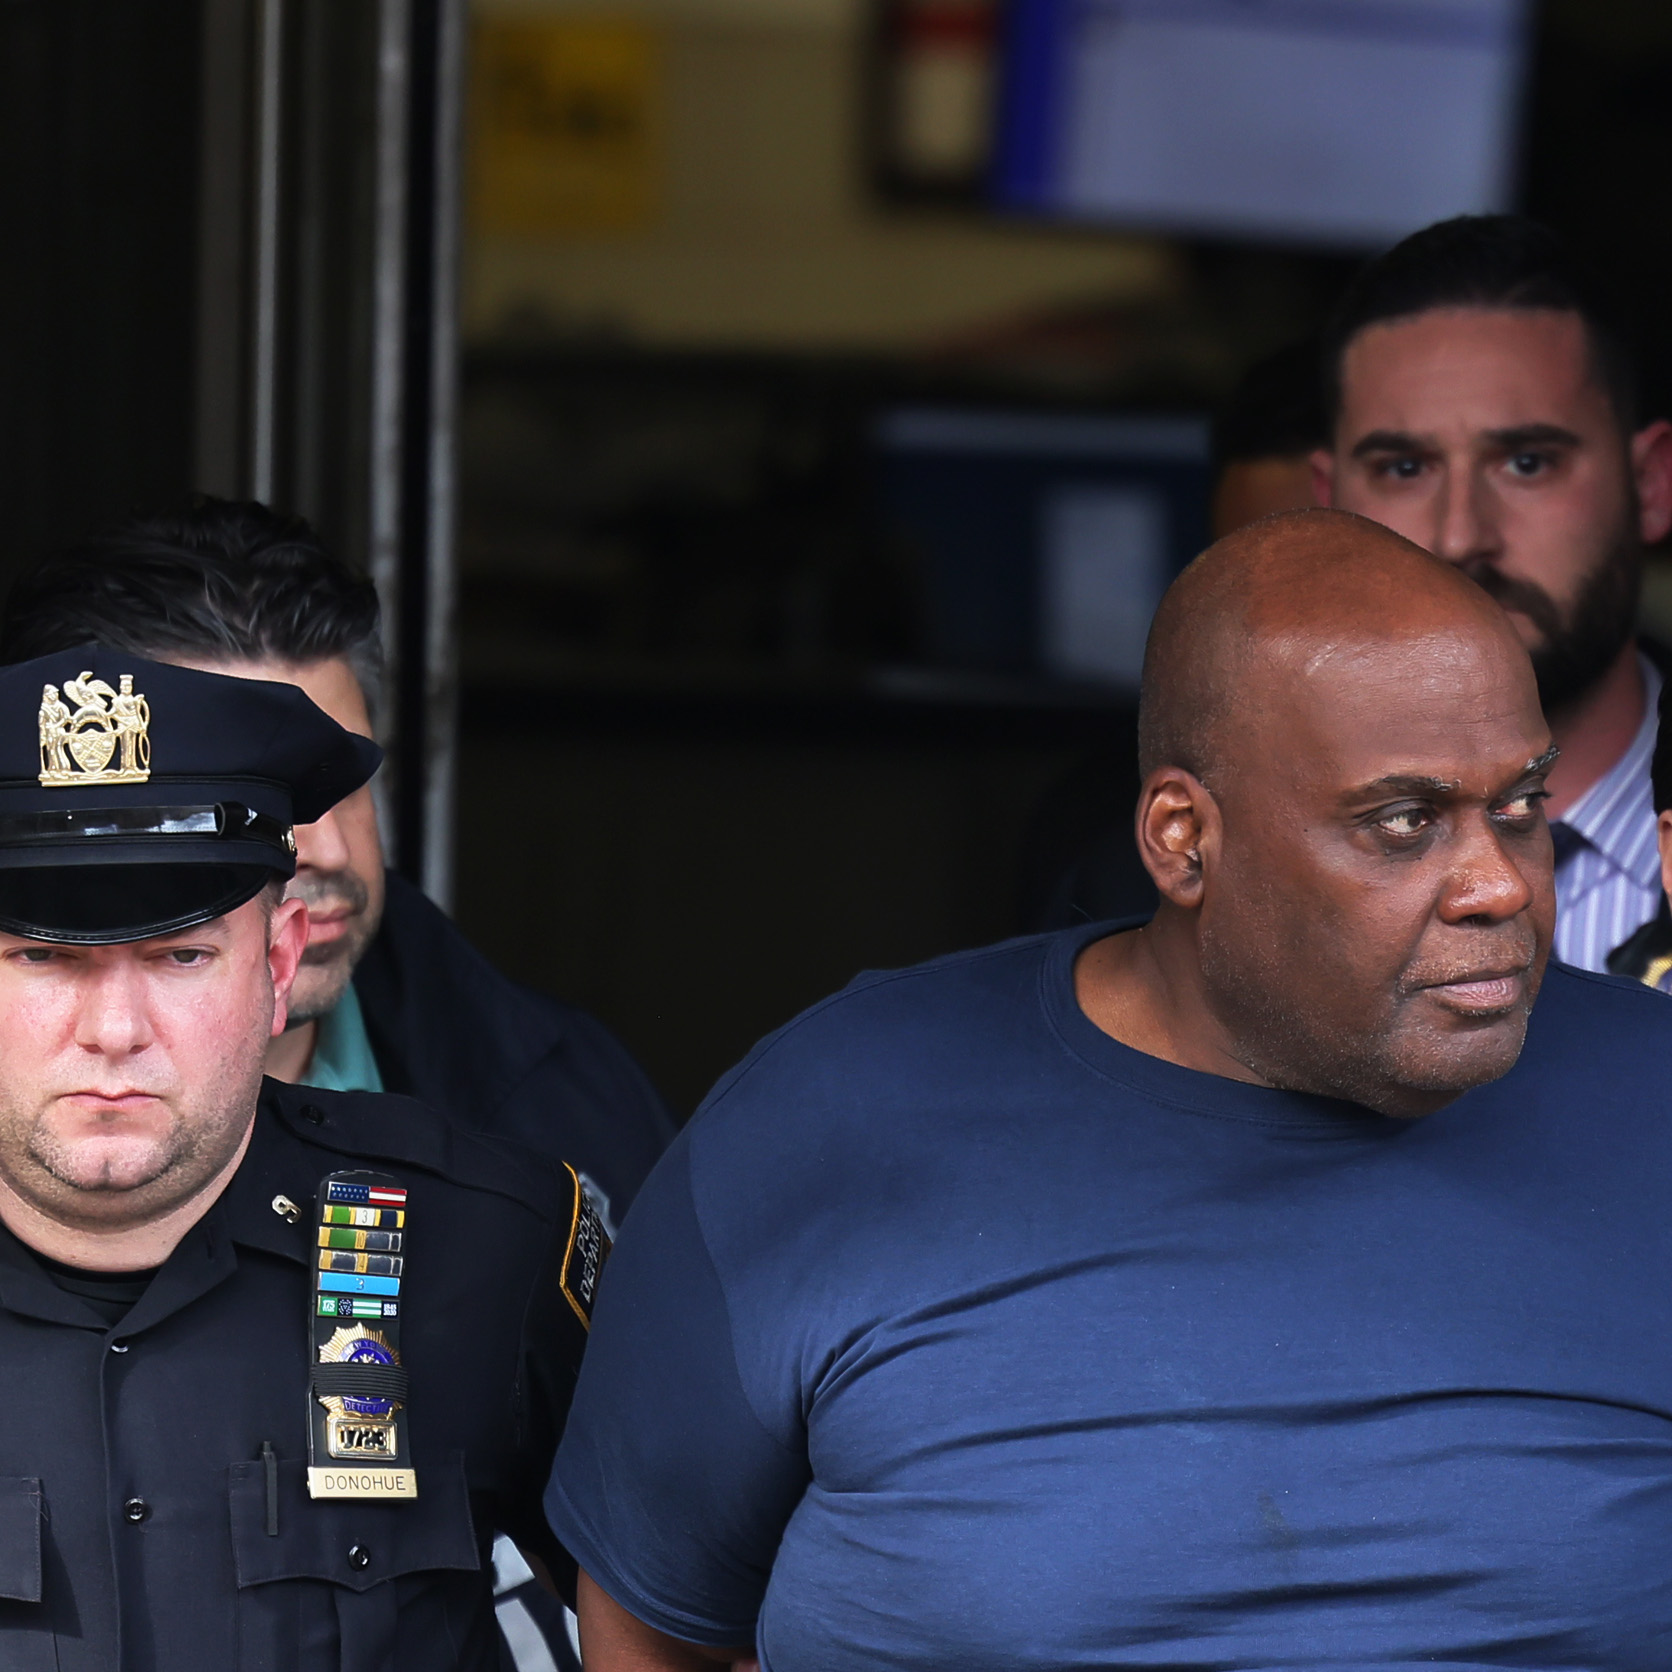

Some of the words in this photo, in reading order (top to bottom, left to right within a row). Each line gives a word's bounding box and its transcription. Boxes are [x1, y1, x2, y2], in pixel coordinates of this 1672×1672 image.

[271, 1194, 302, 1224] 9
[361, 1209, 369, 1224] 3
[355, 1277, 365, 1291] 3
[324, 1475, 407, 1491] DONOHUE
